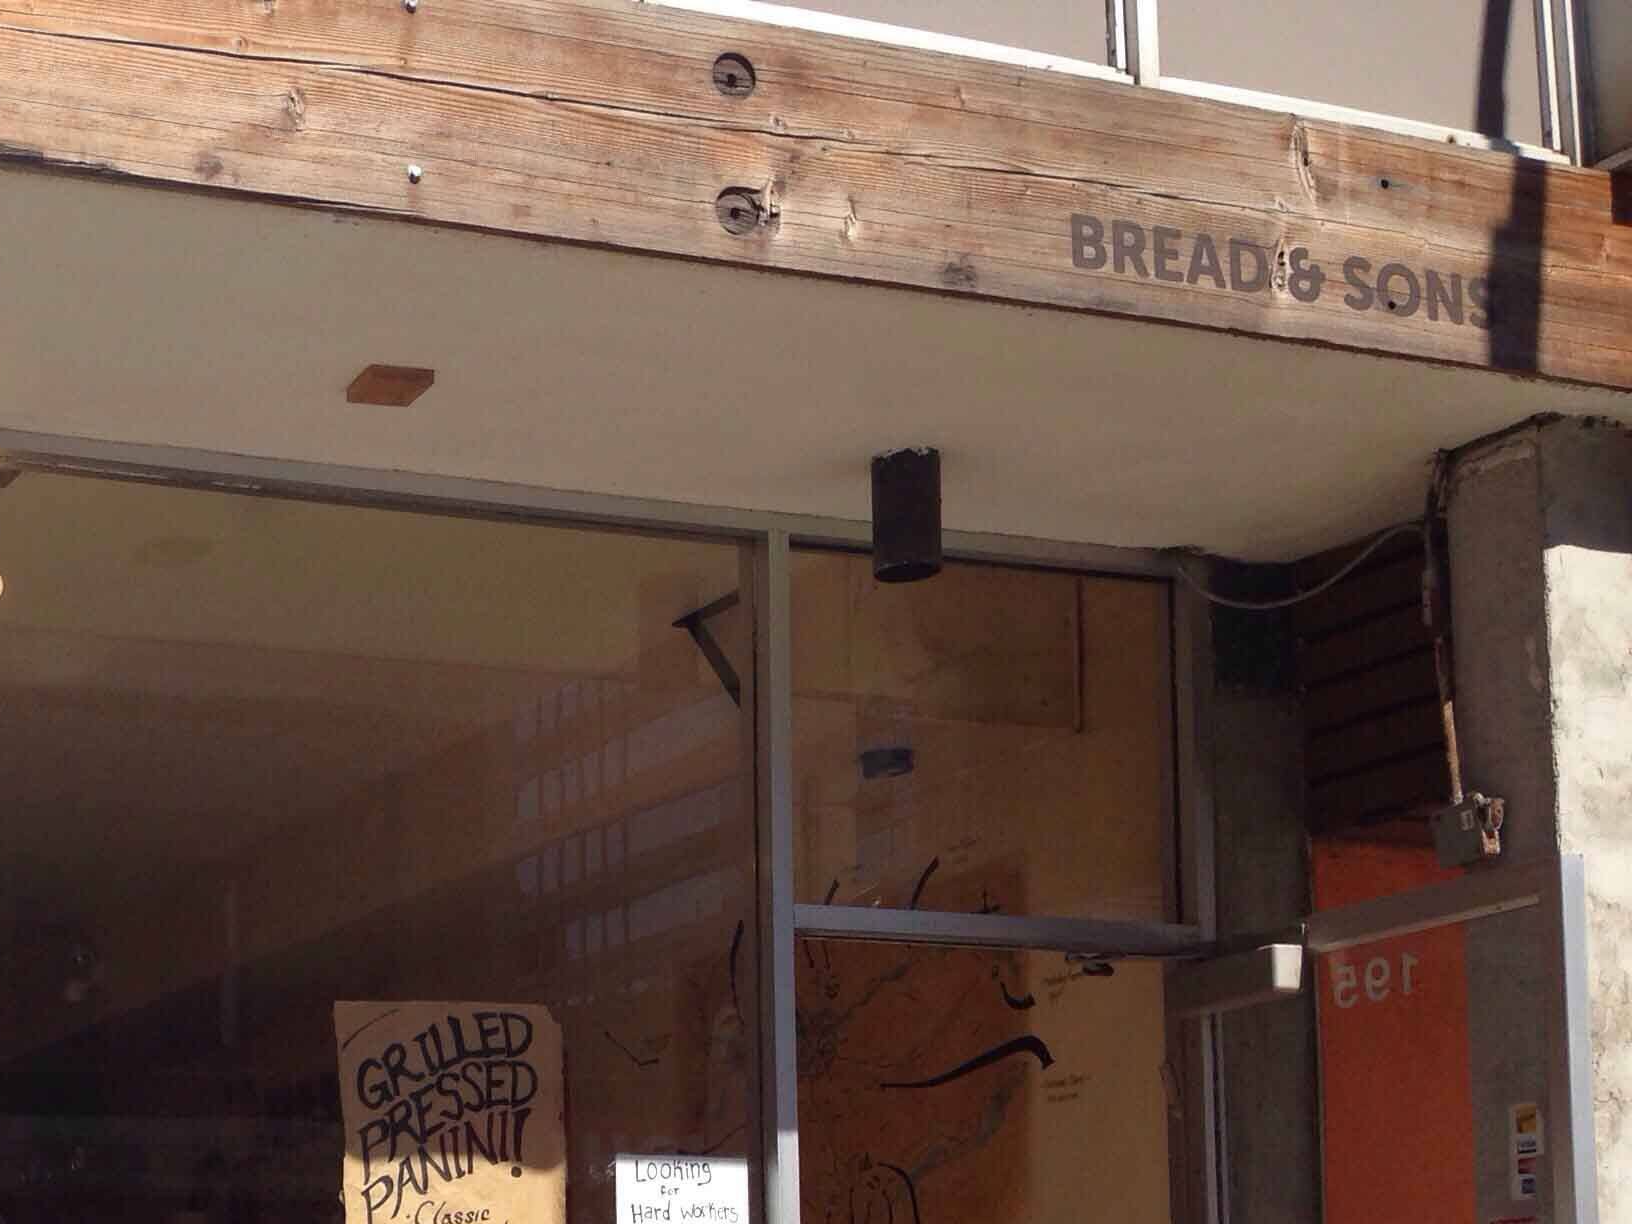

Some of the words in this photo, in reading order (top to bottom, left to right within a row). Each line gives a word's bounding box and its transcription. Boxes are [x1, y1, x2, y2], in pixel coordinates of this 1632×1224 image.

[1070, 213, 1269, 293] BREAD
[1288, 246, 1326, 303] &
[1343, 255, 1489, 330] SONS
[356, 1012, 532, 1110] GRILLED
[356, 1060, 538, 1184] PRESSED
[630, 1200, 671, 1224] Hard
[635, 1159, 712, 1186] Looking
